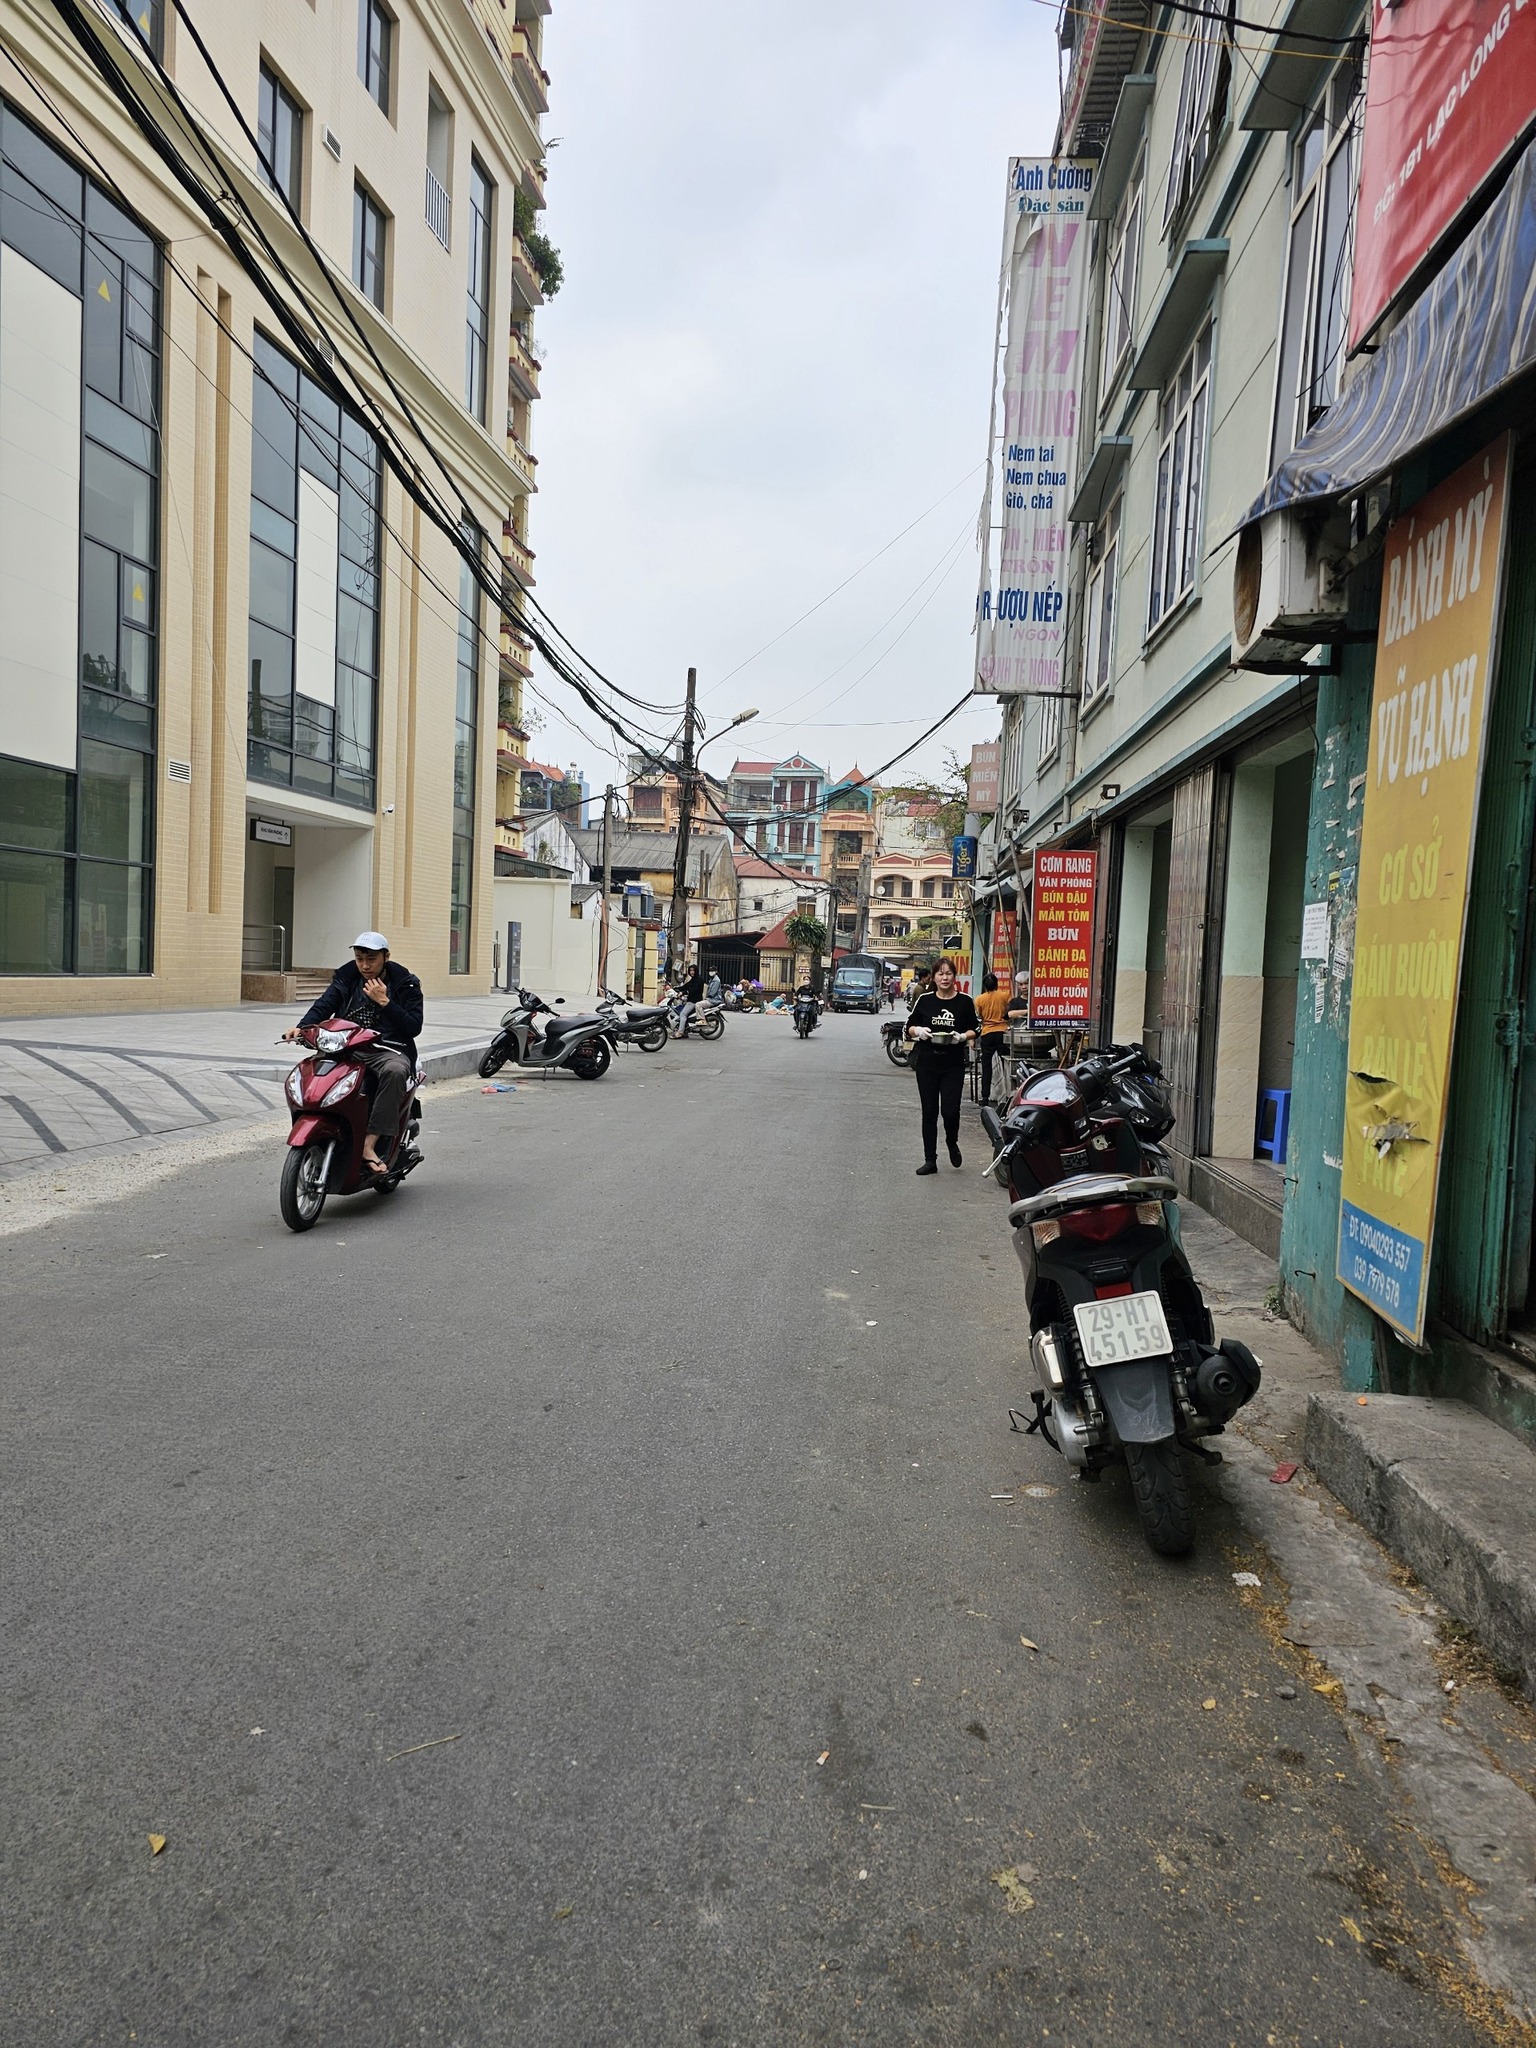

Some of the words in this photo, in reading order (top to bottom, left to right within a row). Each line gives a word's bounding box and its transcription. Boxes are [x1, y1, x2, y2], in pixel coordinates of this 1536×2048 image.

[1399, 137, 1423, 187] 181
[1426, 85, 1457, 150] LẠC
[1460, 4, 1510, 98] LONG
[1016, 165, 1043, 190] Anh
[1048, 160, 1093, 192] Cường
[1057, 196, 1084, 212] sản
[1016, 223, 1080, 374] NEM
[1008, 445, 1035, 461] Nem
[1039, 446, 1054, 462] tai
[1006, 469, 1033, 485] Nem
[1037, 470, 1066, 486] chua
[1006, 492, 1027, 511] Giò,
[1031, 491, 1053, 510] chả
[1033, 521, 1065, 552] MIẾN
[1001, 556, 1056, 577] TRỘN
[1384, 517, 1449, 648] BÁNH
[983, 587, 1029, 628] RƯỢU
[1032, 581, 1063, 622] NẾP
[1029, 653, 1060, 686] NÓNG
[1376, 664, 1407, 789] VŨ
[1404, 653, 1478, 797] HẠNH
[976, 748, 996, 764] BÚN
[956, 846, 972, 875] Tiger
[1040, 856, 1062, 873] CƠM
[1065, 857, 1092, 874] RANG
[1379, 848, 1408, 905] CƠ
[1409, 815, 1443, 900] SỞ
[1038, 875, 1058, 888] VĂN
[1042, 890, 1064, 904] BÚN
[1066, 890, 1087, 906] ĐẬU
[1068, 908, 1090, 922] TÔM
[1047, 925, 1079, 941] BÚN
[1038, 946, 1069, 962] BÁNH
[1071, 948, 1087, 962] ĐA
[1356, 932, 1393, 998] BÁN
[1394, 928, 1455, 1001] BUÔN
[1034, 965, 1047, 979] CÁ
[1049, 965, 1062, 979] RÔ
[1034, 984, 1060, 998] BÁNH
[1062, 983, 1088, 998] CUỐN
[1037, 1004, 1056, 1016] CAO
[1058, 1001, 1084, 1016] BẰNG
[1057, 1020, 1071, 1028] LONG
[1402, 1016, 1427, 1100] LẺ
[1394, 1242, 1411, 1272] 557
[1354, 1255, 1366, 1283] 039
[1385, 1276, 1400, 1308] 578
[1088, 1299, 1149, 1332] 29-H1
[1090, 1325, 1165, 1360] 451.59
